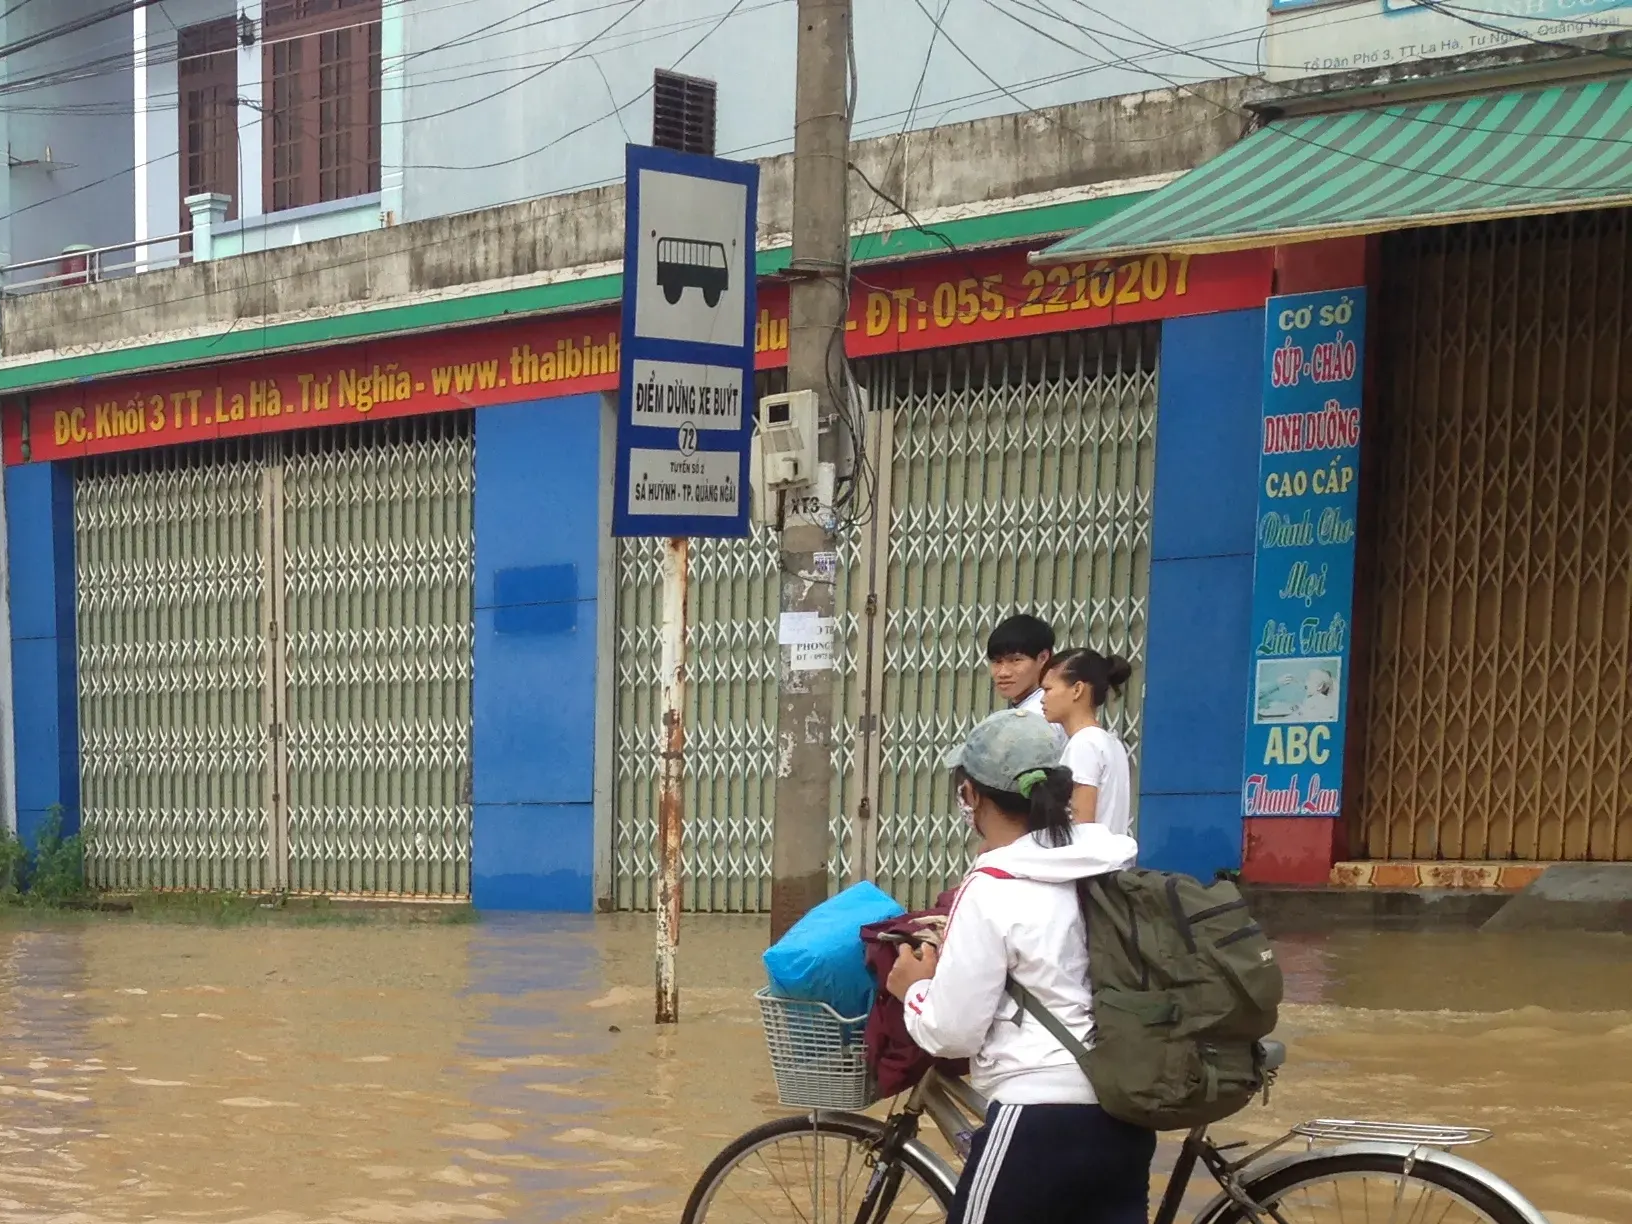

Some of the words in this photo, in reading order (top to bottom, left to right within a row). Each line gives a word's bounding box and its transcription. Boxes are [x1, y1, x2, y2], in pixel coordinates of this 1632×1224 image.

[1323, 57, 1349, 69] Dân
[1353, 48, 1380, 64] Phố
[1278, 304, 1314, 331] CƠ
[1319, 295, 1355, 327] SỞ
[1271, 335, 1304, 388] SÚP
[1311, 329, 1357, 385] CHÁO
[95, 391, 146, 440] Khối
[149, 394, 166, 432] 3
[215, 386, 245, 424] La
[298, 373, 333, 413] Tư
[337, 362, 412, 413] Nghĩa
[636, 370, 664, 413] ĐIỂM
[667, 378, 696, 415] DỪNG
[698, 386, 711, 416] XE
[713, 382, 739, 416] BUÝT
[681, 427, 695, 450] 72
[1263, 412, 1304, 455] DINH
[1304, 398, 1361, 451] DƯỠNG
[700, 464, 705, 475] 2
[1265, 469, 1308, 498] CAO
[1312, 454, 1354, 496] CẤP
[1259, 508, 1314, 548] Dành
[1317, 506, 1355, 546] Cho
[1279, 560, 1329, 608] Mọi
[1256, 618, 1296, 656] Lứa
[1299, 611, 1348, 655] Tuổi
[1263, 724, 1331, 765] ABC
[1245, 773, 1301, 816] Thanh
[1301, 772, 1340, 816] Lan
